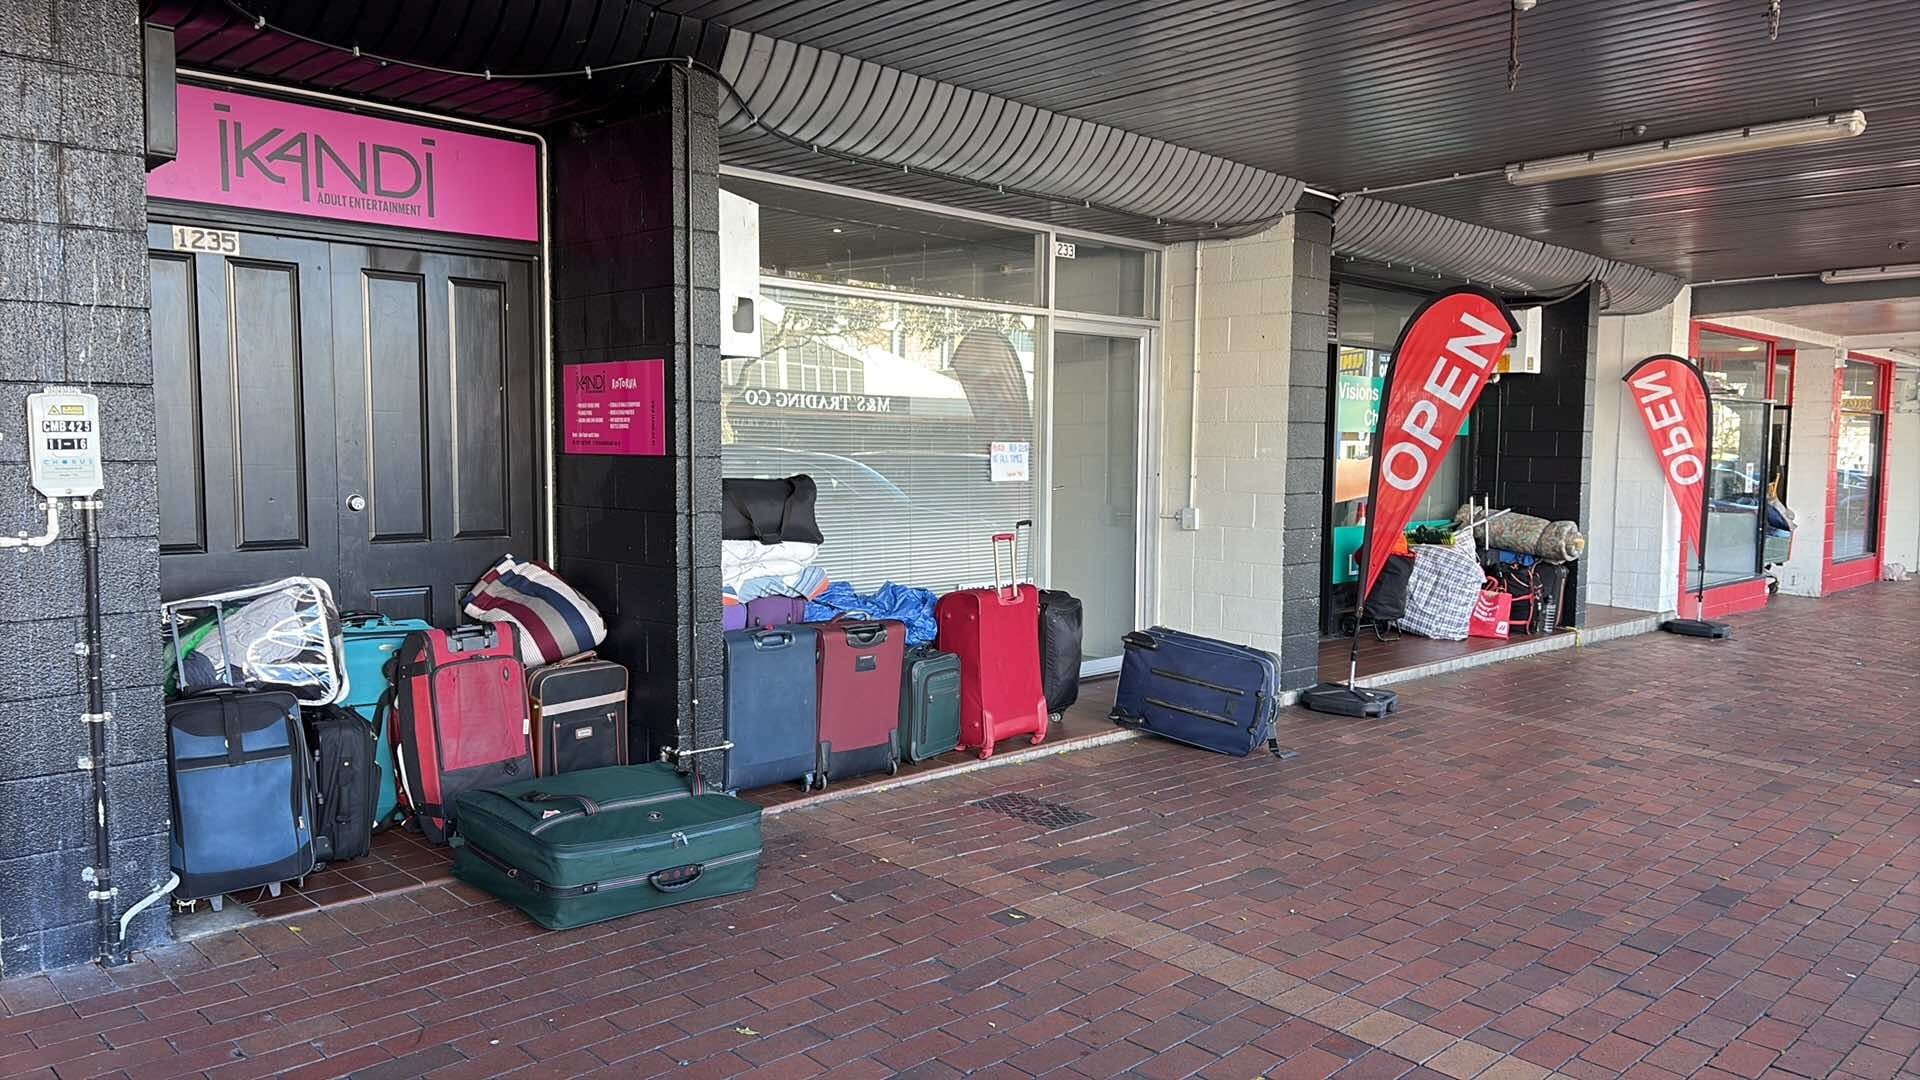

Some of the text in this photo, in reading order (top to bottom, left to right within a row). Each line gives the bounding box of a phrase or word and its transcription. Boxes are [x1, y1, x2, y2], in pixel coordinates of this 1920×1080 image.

[318, 191, 422, 217] ADULT ENTERTAINMENT
[176, 228, 236, 253] 1235
[1339, 382, 1379, 401] Visions
[1382, 312, 1505, 490] OPEN
[48, 439, 87, 449] 11-16
